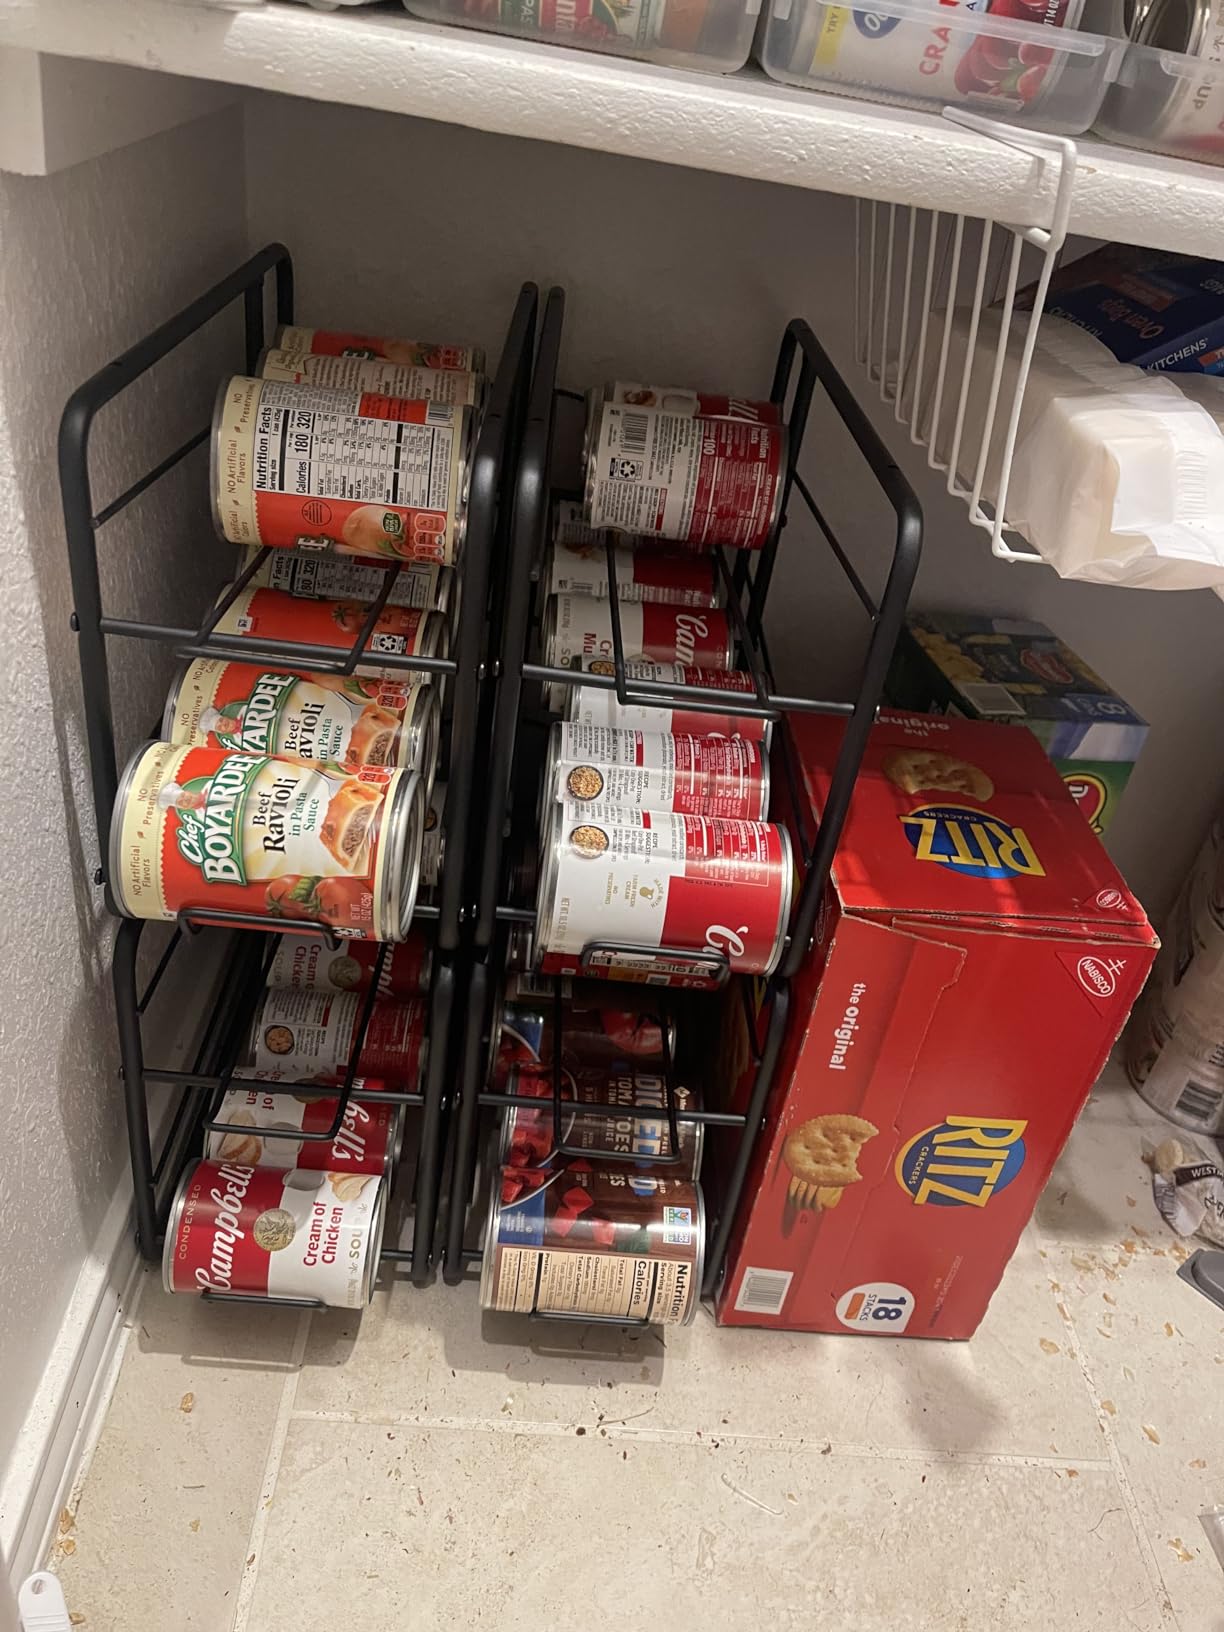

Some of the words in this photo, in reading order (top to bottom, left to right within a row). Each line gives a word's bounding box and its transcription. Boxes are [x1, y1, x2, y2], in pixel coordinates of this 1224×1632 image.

[234, 393, 242, 404] NO
[259, 407, 272, 435] Facts
[297, 411, 312, 429] 320
[295, 434, 309, 453] 180
[704, 438, 716, 455] 100
[228, 440, 237, 480] Artificial
[238, 453, 247, 484] Flavors
[256, 438, 269, 489] Nutrition
[229, 480, 237, 494] NO
[269, 470, 278, 491] Serving
[296, 461, 307, 494] Calories
[303, 559, 315, 575] 320
[301, 579, 314, 597] 80
[181, 712, 190, 727] NO
[285, 718, 301, 752] Beef
[299, 703, 326, 760] avioli
[319, 717, 333, 747] Pasta
[330, 724, 344, 756] Sauce
[138, 787, 148, 801] NO
[144, 770, 165, 826] Preservatives
[252, 791, 272, 827] Beef
[292, 791, 308, 823] Pasta
[204, 753, 269, 884] BOYARDEE
[263, 776, 300, 855] Ravioli
[288, 823, 300, 837] in
[305, 796, 320, 832] Sauce
[922, 810, 979, 822] CRACKERS
[179, 813, 208, 864] Chef
[899, 815, 1046, 877] RITZ
[134, 845, 142, 882] Artificial
[142, 858, 151, 888] Flavors
[134, 881, 142, 897] NO
[309, 944, 322, 974] Cream
[1081, 958, 1112, 995] NABISCO
[849, 983, 866, 1006] the
[829, 1006, 859, 1070] original
[908, 1145, 929, 1185] CRACKERS
[914, 1115, 1029, 1207] RITZ
[178, 1184, 201, 1260] CONDENSED
[313, 1201, 327, 1218] of
[195, 1164, 255, 1292] Campbell's
[303, 1221, 325, 1267] Cream
[322, 1207, 344, 1264] Chicken
[349, 1222, 363, 1259] SOU
[584, 1256, 592, 1279] Sodium
[591, 1256, 600, 1291] Cholesterol
[632, 1260, 647, 1305] Calories
[656, 1262, 667, 1290] Serving
[666, 1263, 674, 1282] About
[669, 1264, 688, 1317] Nutrition
[859, 1293, 878, 1321] STACKS
[871, 1296, 908, 1322] 18
